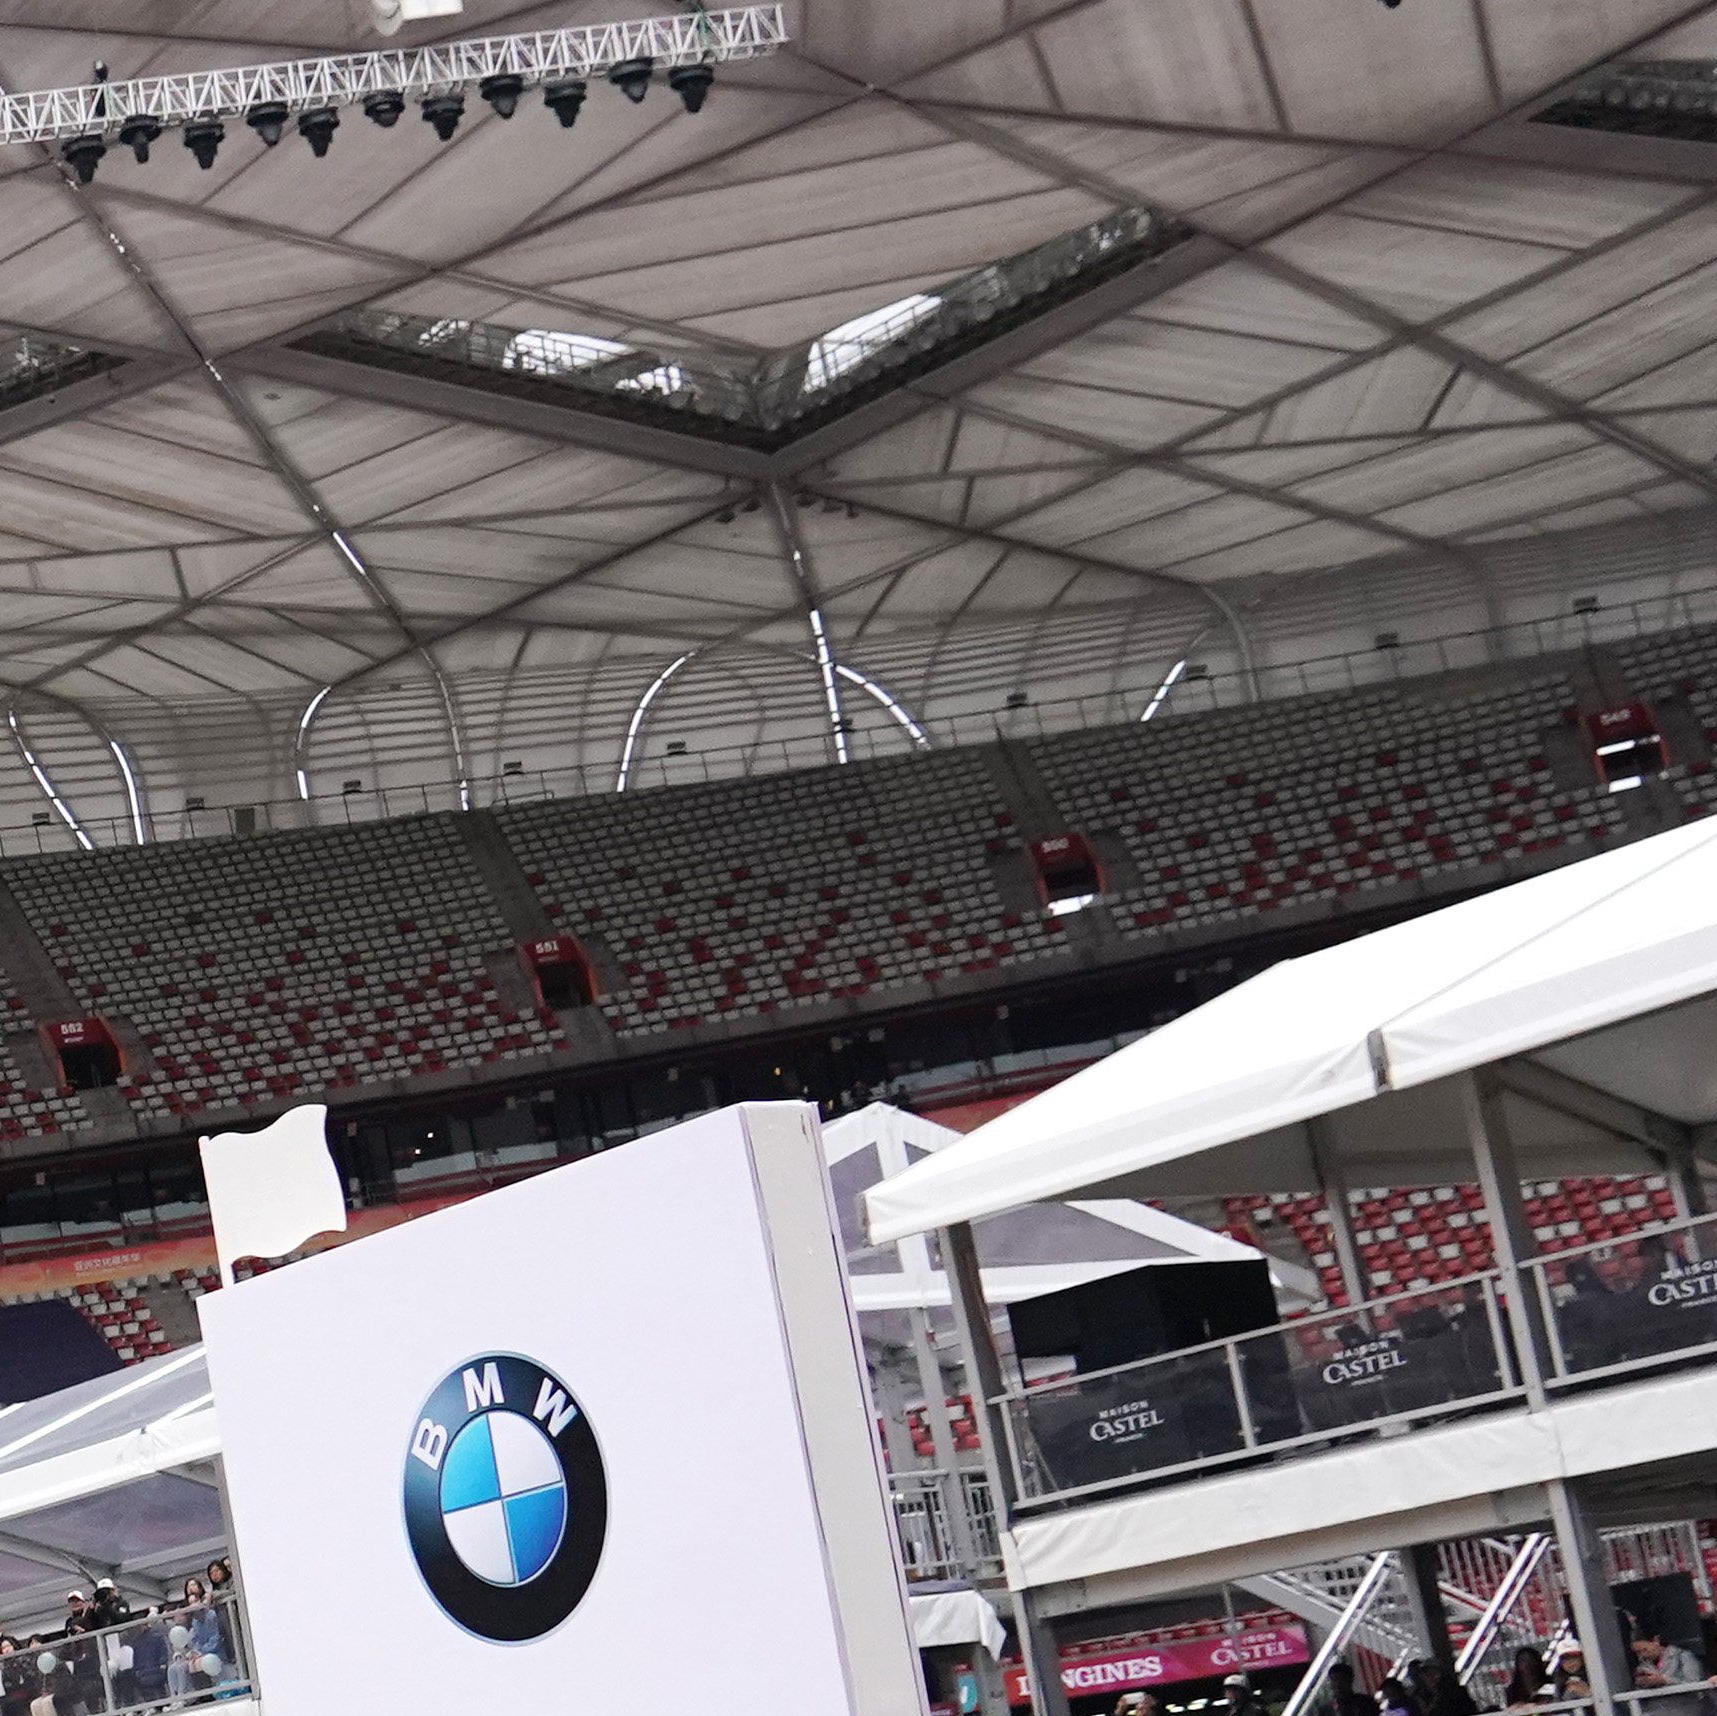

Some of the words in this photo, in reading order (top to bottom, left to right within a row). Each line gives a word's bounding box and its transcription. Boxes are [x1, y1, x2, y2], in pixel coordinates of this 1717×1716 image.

[1648, 1273, 1717, 1305] CAST
[1323, 1350, 1407, 1384] CASTEL
[410, 1361, 578, 1471] BMW
[1089, 1409, 1165, 1441] CASTEL
[1015, 1656, 1163, 1696] LNGINES
